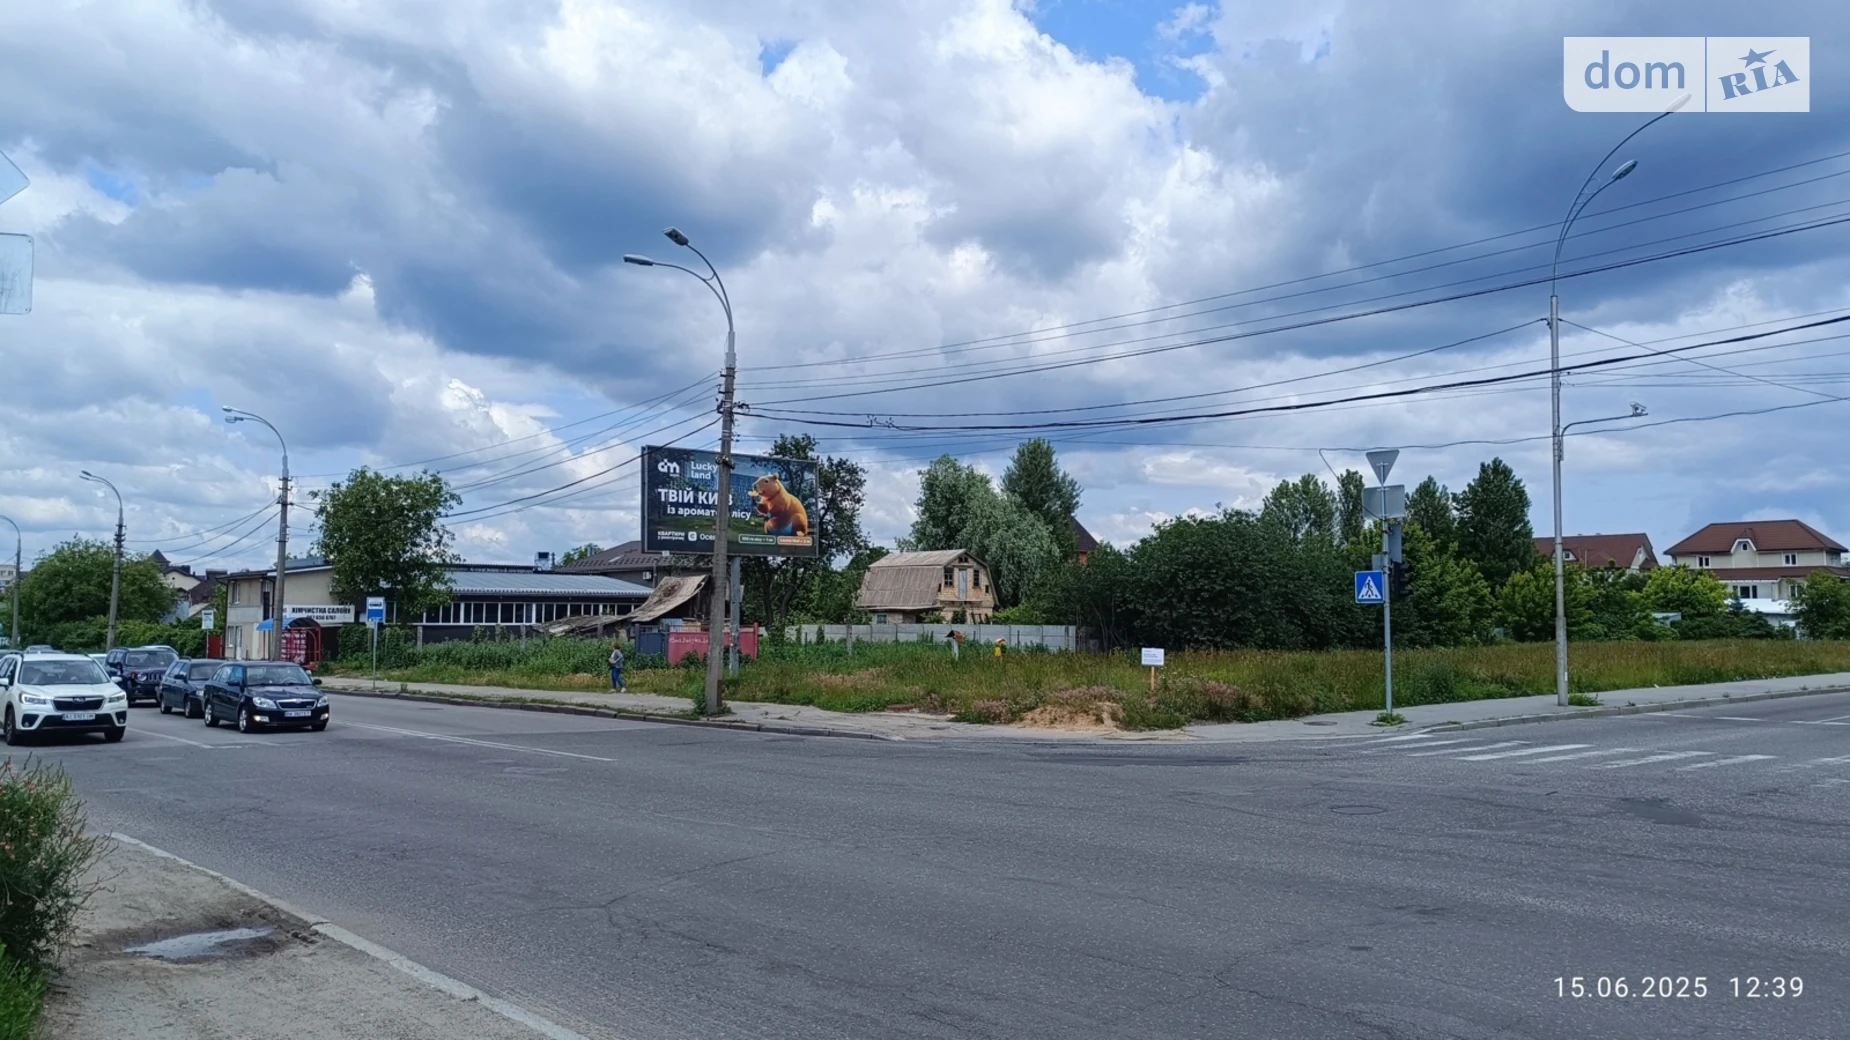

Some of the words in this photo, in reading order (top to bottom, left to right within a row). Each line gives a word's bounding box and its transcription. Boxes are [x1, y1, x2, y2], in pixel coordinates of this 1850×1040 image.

[691, 461, 718, 473] Lucky
[691, 470, 711, 479] land
[658, 487, 694, 503] ТВІЙ
[698, 491, 733, 505] КИ
[667, 505, 676, 514] із
[678, 507, 729, 517] аромат
[731, 509, 751, 520] лісу
